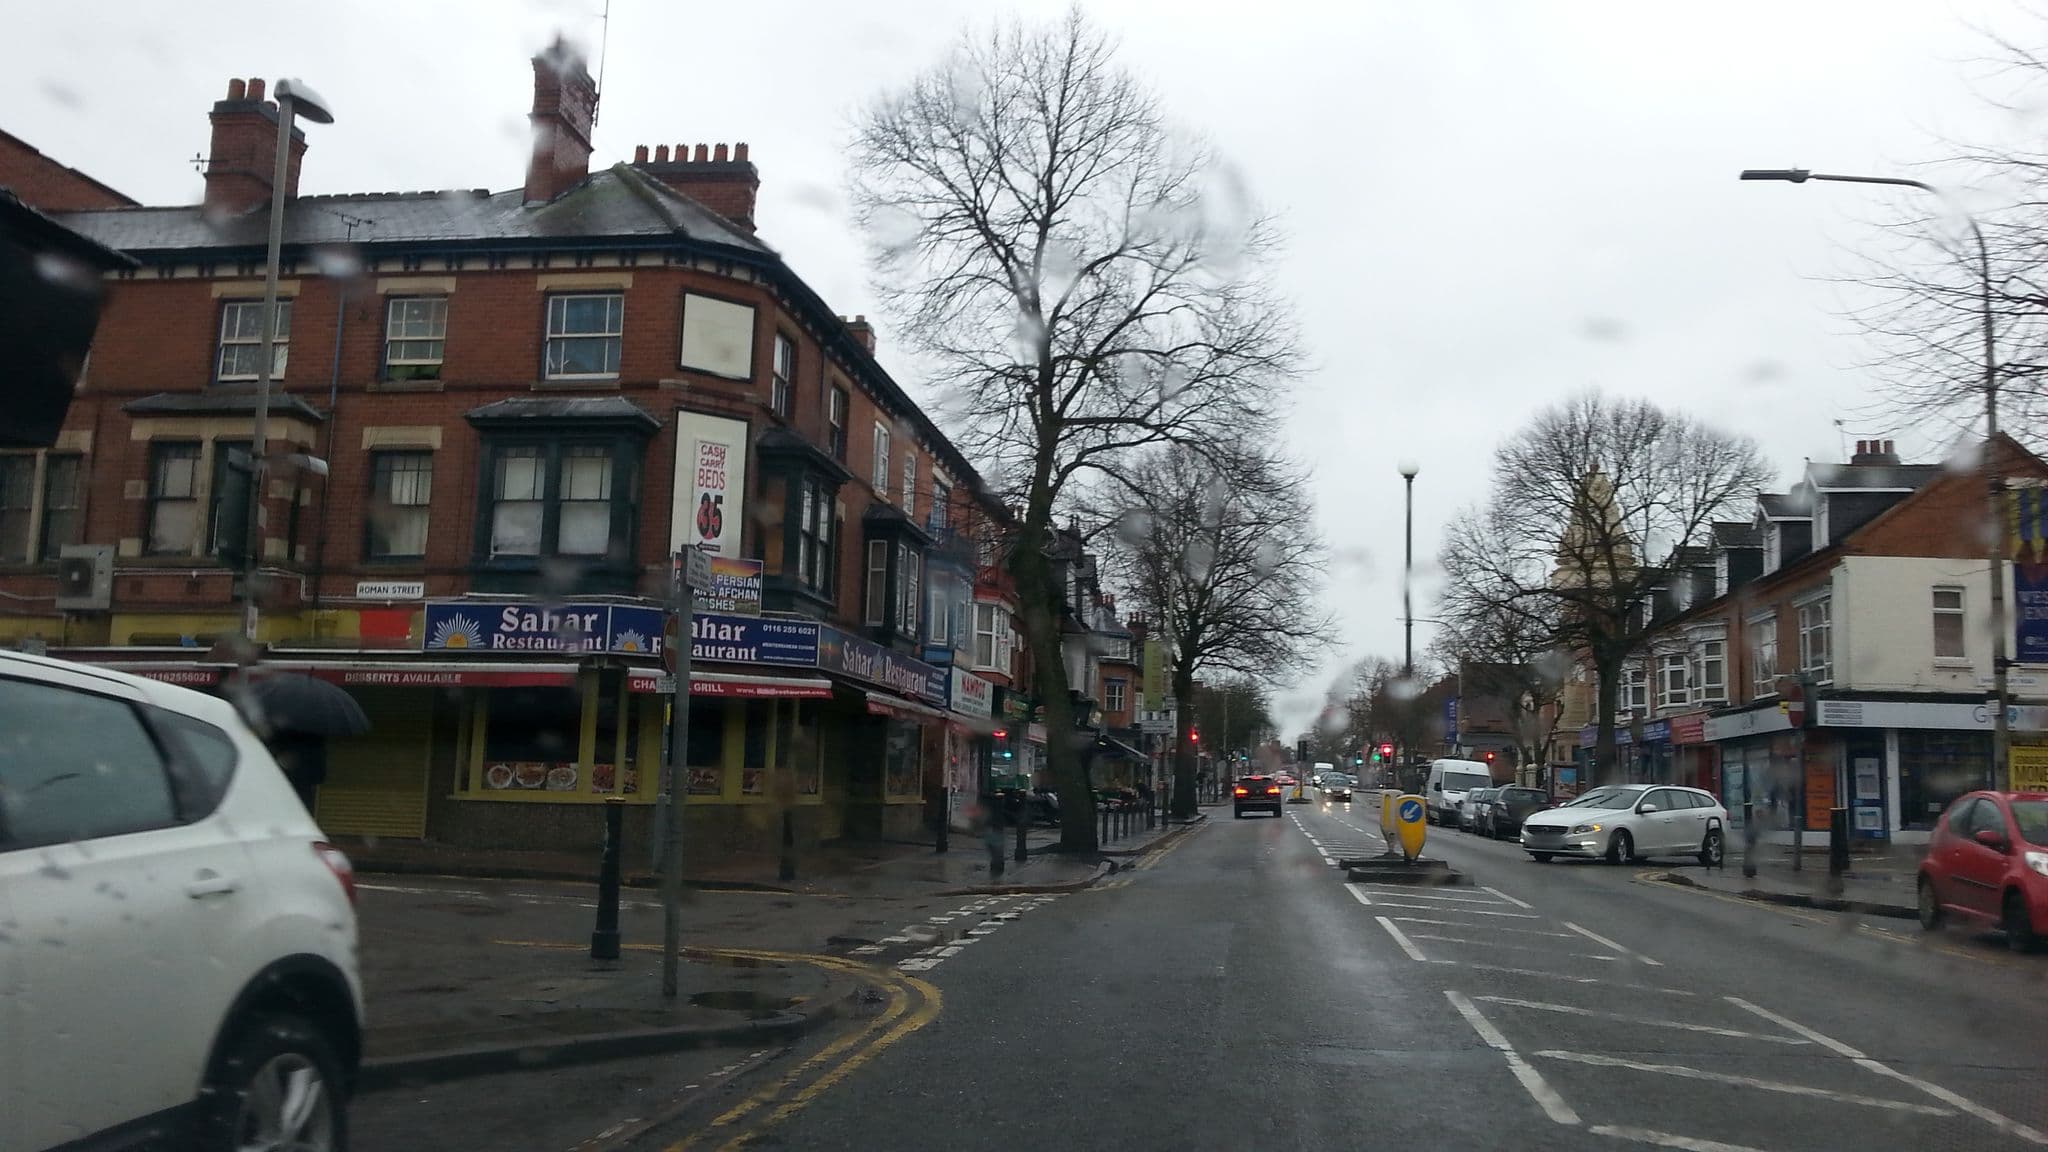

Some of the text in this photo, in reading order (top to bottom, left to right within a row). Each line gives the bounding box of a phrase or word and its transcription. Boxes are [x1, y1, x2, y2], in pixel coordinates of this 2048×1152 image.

[700, 444, 726, 459] CASH
[700, 457, 725, 469] CARRY
[698, 468, 725, 490] BEDS
[716, 574, 760, 589] PERSIAN
[358, 585, 421, 594] ROMAN STREET
[719, 587, 758, 600] AFGHAN
[500, 606, 598, 633] Sahar
[690, 617, 746, 642] ahar
[651, 636, 757, 661] Raurant
[842, 640, 872, 677] Sahar
[885, 656, 928, 696] Restaurant
[344, 672, 463, 684] DESSERTS AVAILABLE
[693, 682, 725, 693] GRILL
